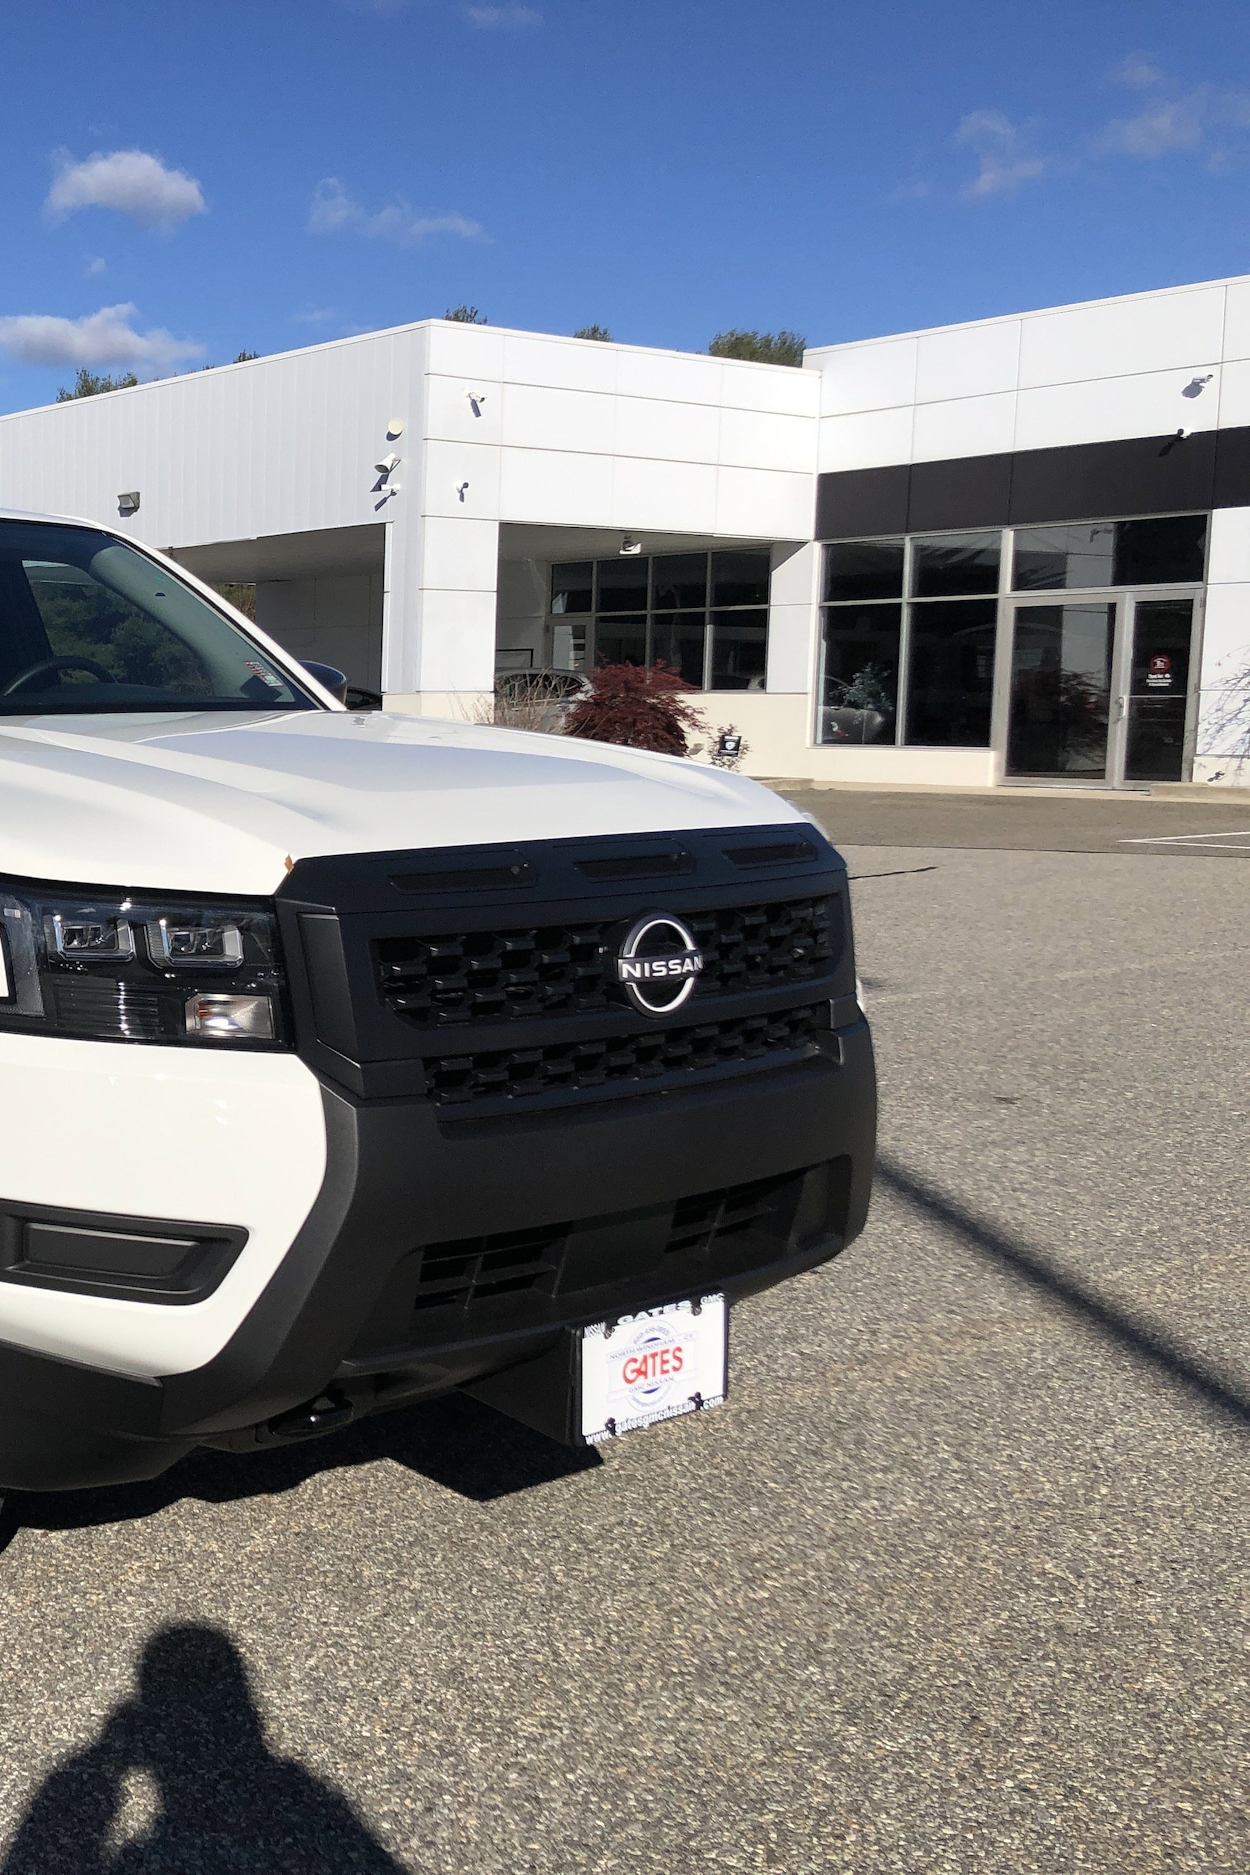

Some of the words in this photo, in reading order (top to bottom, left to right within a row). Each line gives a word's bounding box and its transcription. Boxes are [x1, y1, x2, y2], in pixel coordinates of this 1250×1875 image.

[622, 955, 703, 978] NISSAN
[617, 1300, 692, 1325] GATES
[622, 1345, 684, 1385] GATES
